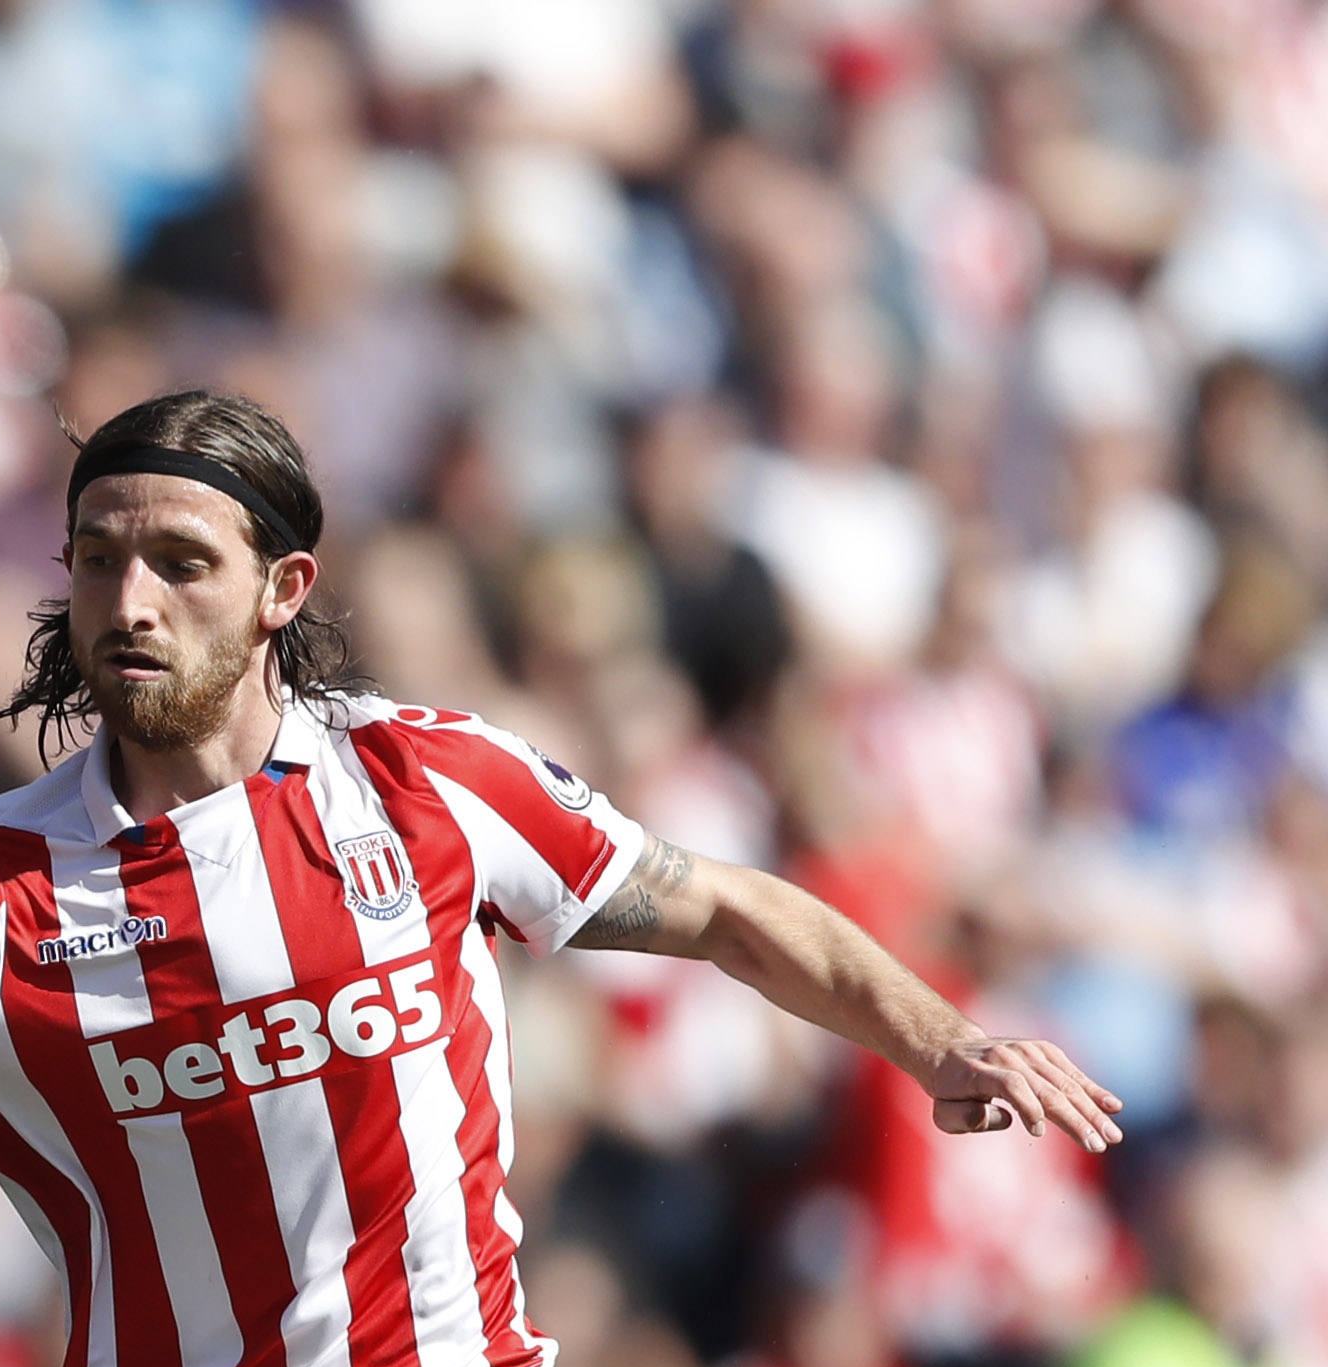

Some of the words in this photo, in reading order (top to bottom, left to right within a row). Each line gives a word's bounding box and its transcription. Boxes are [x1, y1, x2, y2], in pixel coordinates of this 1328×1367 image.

[342, 835, 391, 855] STOKE
[37, 915, 167, 964] macron
[88, 959, 443, 1113] bet365
